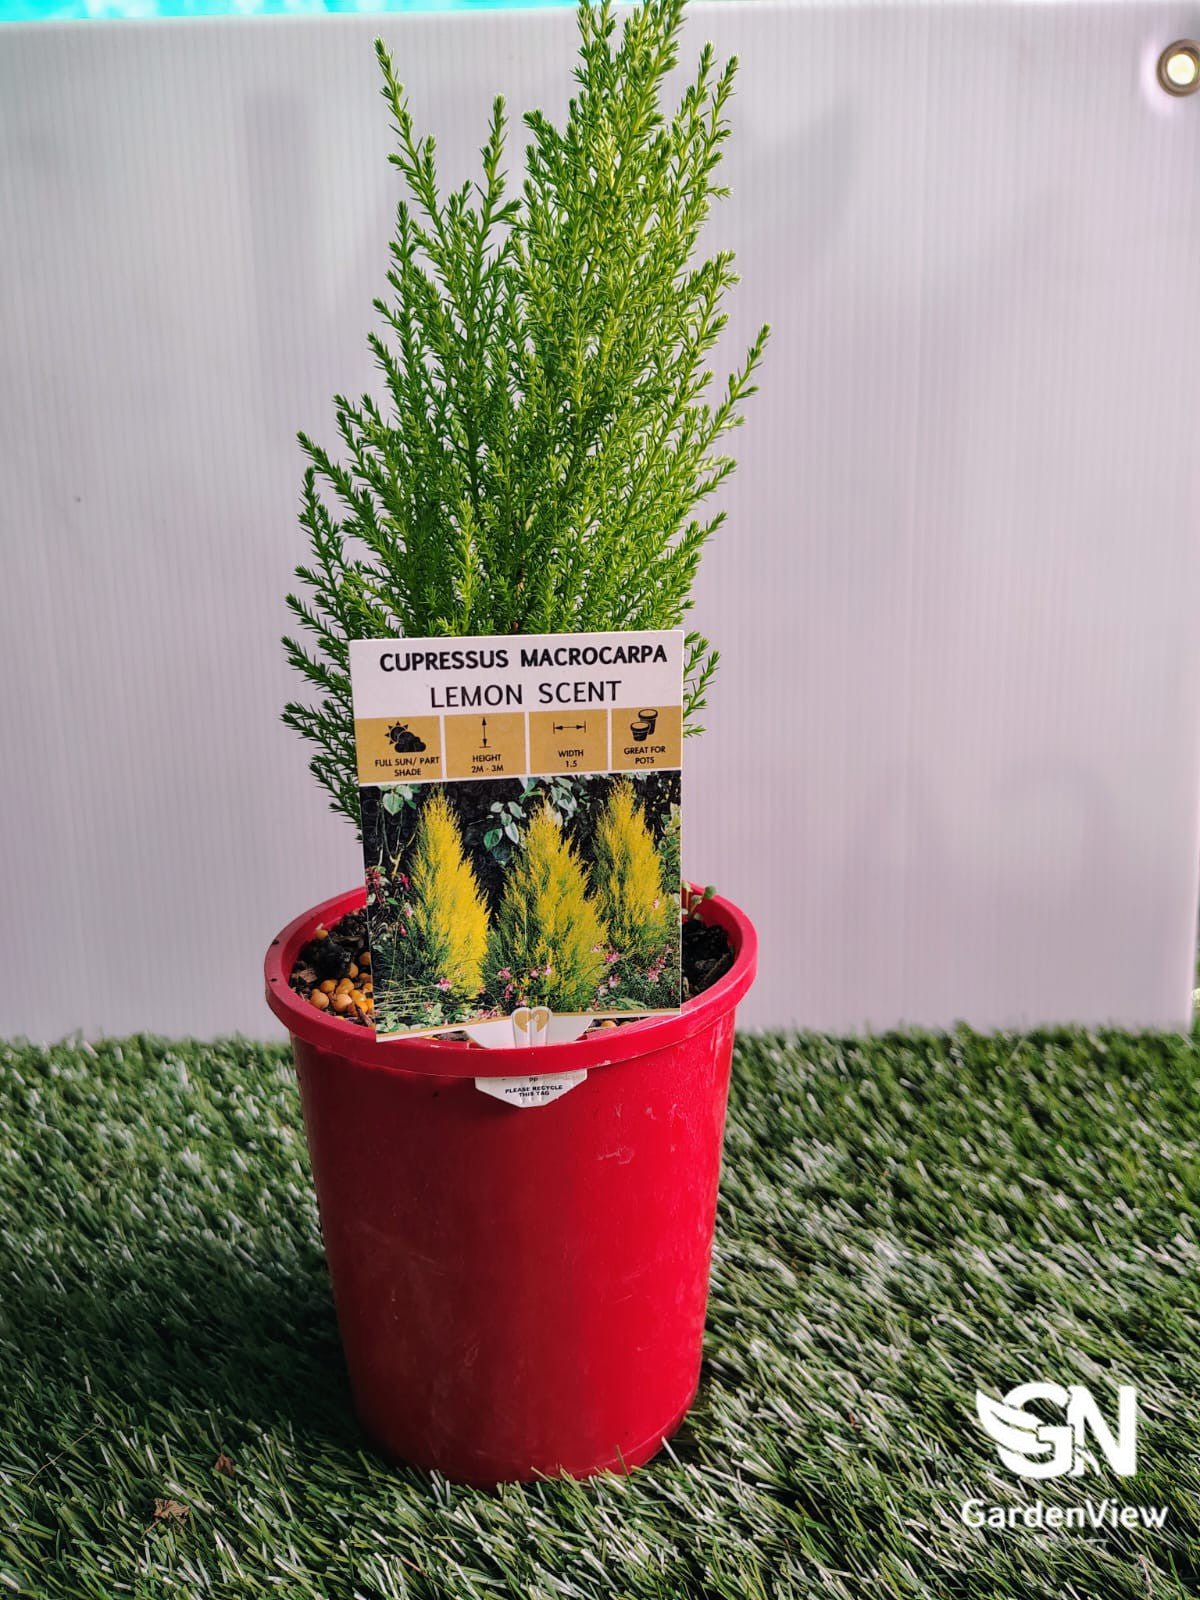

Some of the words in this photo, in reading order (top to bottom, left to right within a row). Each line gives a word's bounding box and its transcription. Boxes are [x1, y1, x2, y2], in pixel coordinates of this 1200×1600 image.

[379, 649, 509, 672] CUPRESSUS
[520, 644, 668, 668] MACROCARPA
[430, 683, 523, 708] LEMON
[538, 680, 622, 704] SCENT
[558, 749, 584, 758] WIDTH
[623, 747, 648, 755] GREAT
[650, 745, 666, 753] FOR
[374, 759, 393, 767] FULL
[394, 757, 417, 766] SUN/
[419, 756, 440, 765] PART
[472, 754, 502, 762] HEIGHT
[634, 757, 655, 765] POTS
[471, 765, 484, 773] 2M
[491, 764, 504, 772] 3M
[565, 760, 578, 768] 1.5
[394, 768, 422, 777] SHADE
